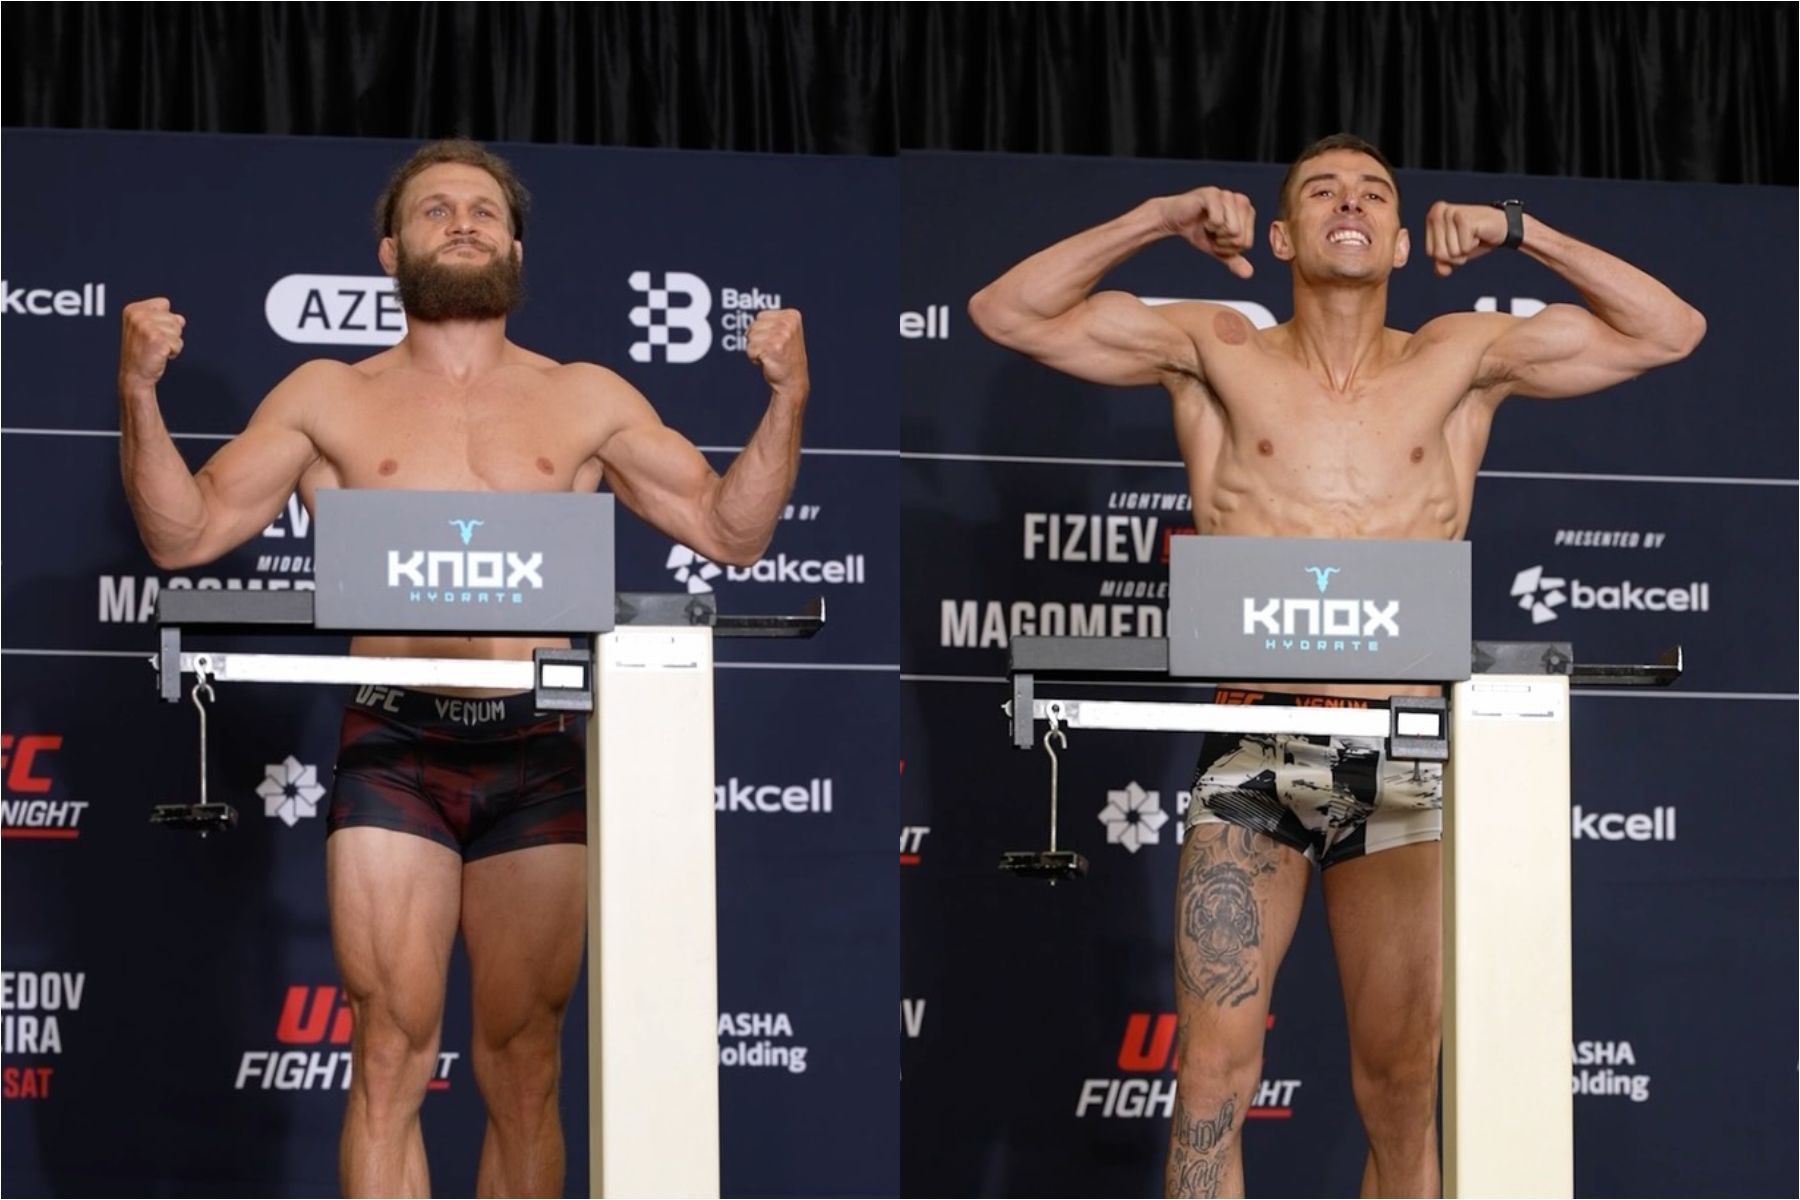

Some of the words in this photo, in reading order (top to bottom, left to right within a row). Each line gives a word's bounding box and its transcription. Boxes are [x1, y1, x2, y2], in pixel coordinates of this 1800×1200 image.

[1, 280, 105, 317] kcell
[721, 287, 781, 310] Baku
[1023, 513, 1158, 563] FIZIEV
[1554, 530, 1640, 548] PRESENTED
[1643, 532, 1666, 548] BY
[257, 555, 316, 573] MIDDL
[410, 591, 523, 603] HYDRATE
[1571, 579, 1709, 612] bakcell
[941, 599, 1171, 648] MAGOMED
[1265, 640, 1379, 651] HYDRATE
[435, 699, 505, 726] VENUM
[1, 800, 88, 827] NIGHT
[1572, 805, 1676, 840] kcell
[1, 1015, 62, 1054] IRA
[718, 1040, 808, 1074] olding
[4, 1067, 54, 1099] SAT
[1251, 1079, 1302, 1107] HT
